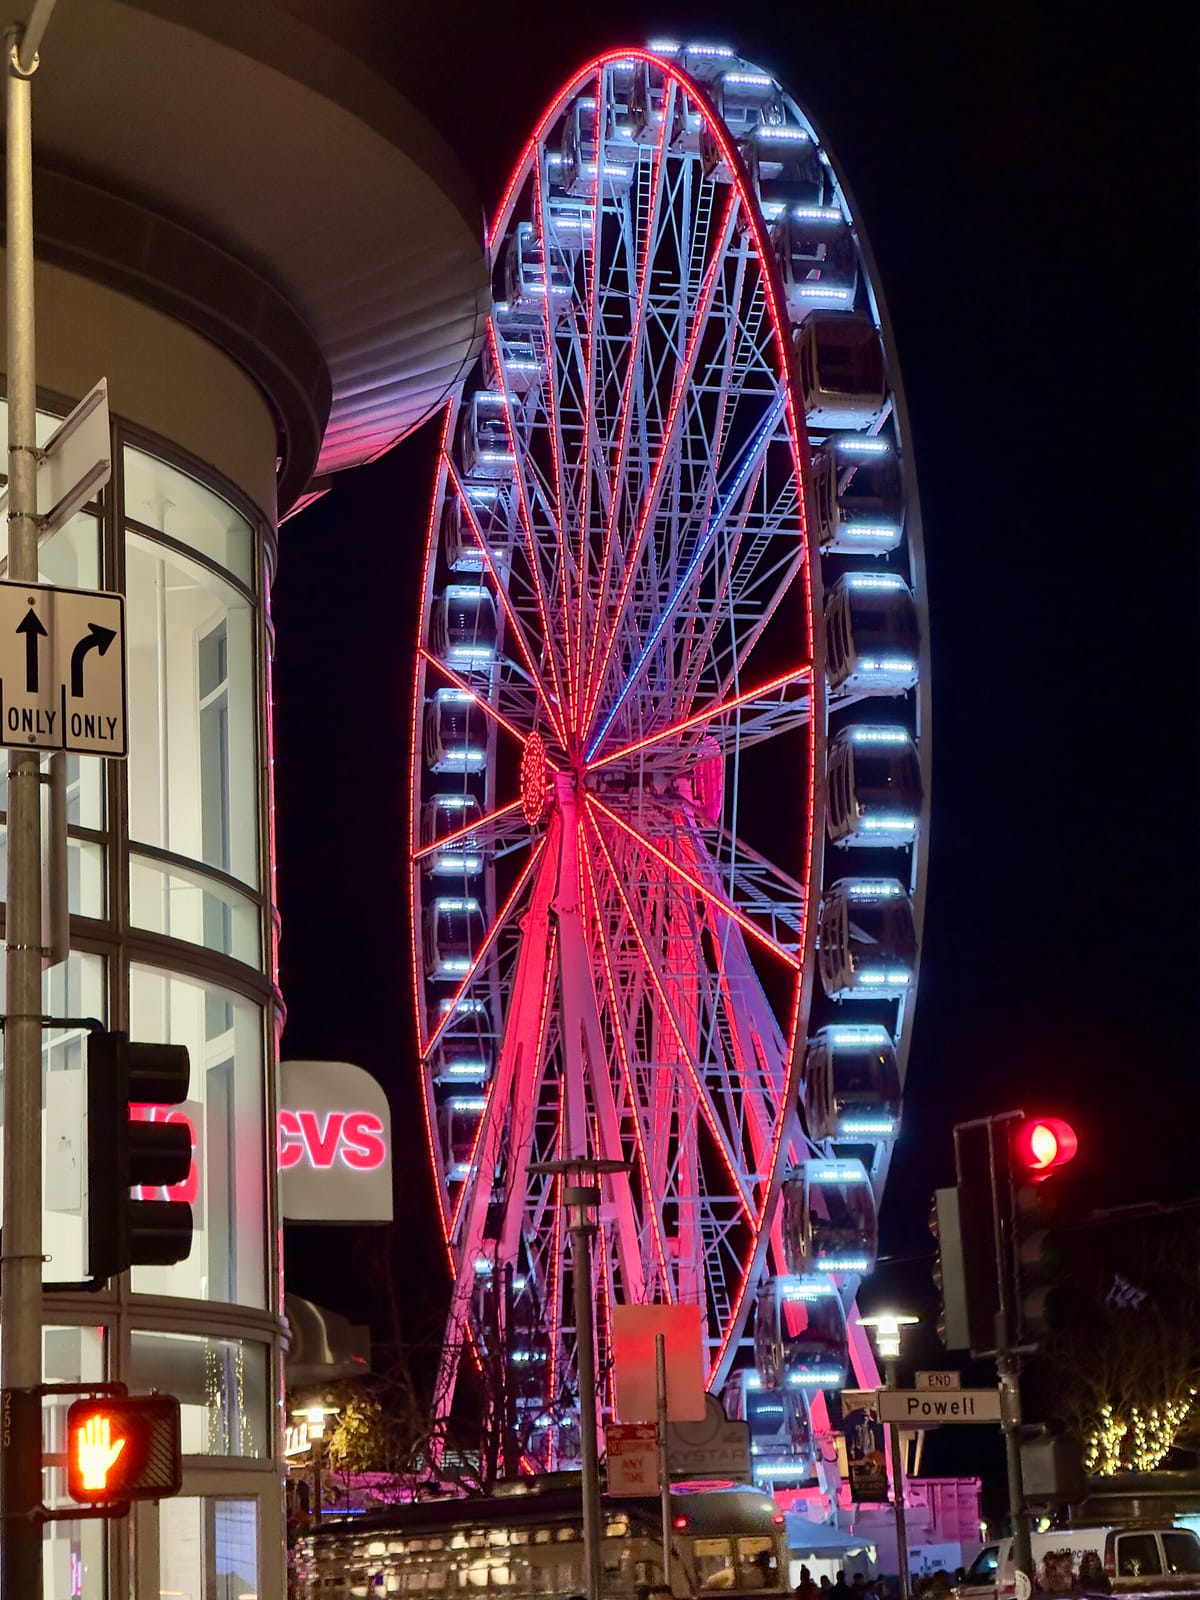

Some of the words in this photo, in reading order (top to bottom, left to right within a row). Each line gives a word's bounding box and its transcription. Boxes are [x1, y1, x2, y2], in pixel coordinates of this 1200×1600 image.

[8, 707, 56, 735] ONLY
[71, 713, 117, 740] ONLY
[277, 1110, 386, 1170] CVS
[928, 1375, 951, 1387] END
[906, 1398, 975, 1415] Powell
